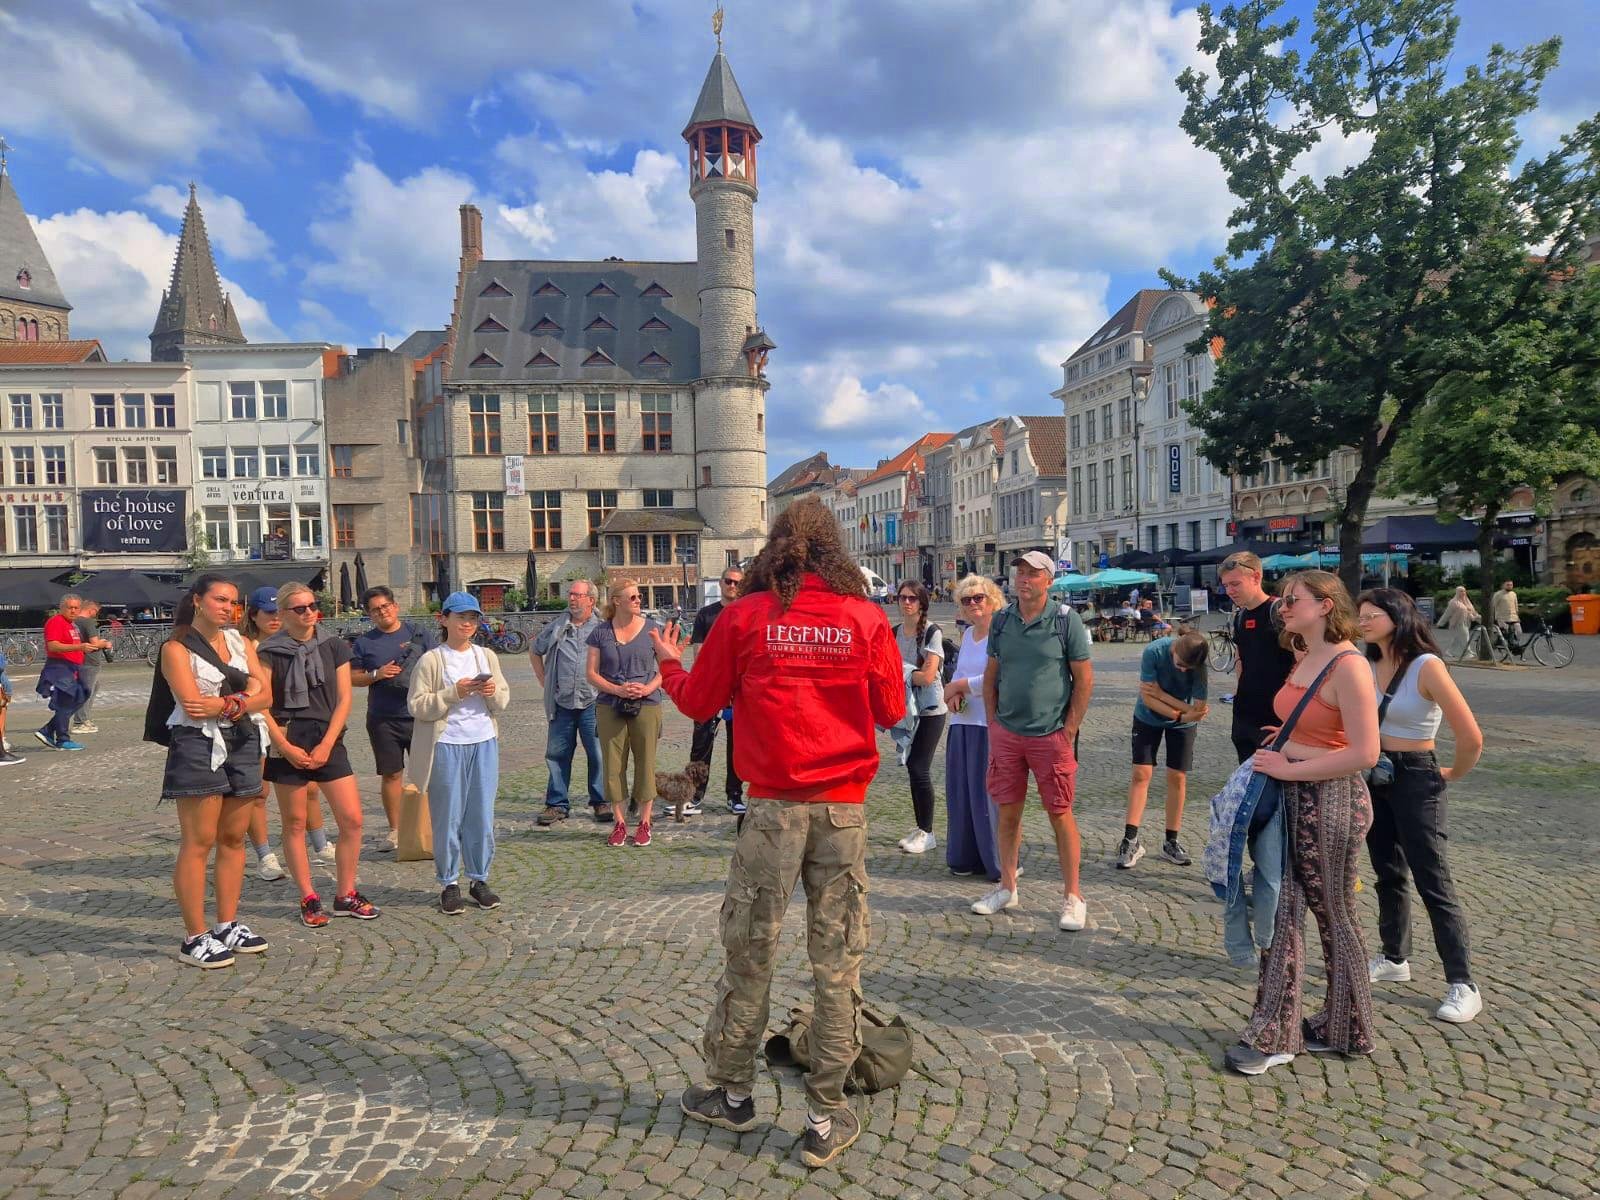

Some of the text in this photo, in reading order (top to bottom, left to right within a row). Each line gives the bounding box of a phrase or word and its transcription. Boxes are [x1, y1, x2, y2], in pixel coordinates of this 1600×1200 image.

[1171, 446, 1179, 486] ODE
[233, 488, 285, 501] ventura
[93, 497, 176, 513] the house
[106, 515, 163, 531] of love
[120, 536, 150, 544] ventura
[767, 625, 852, 644] LEGENDS
